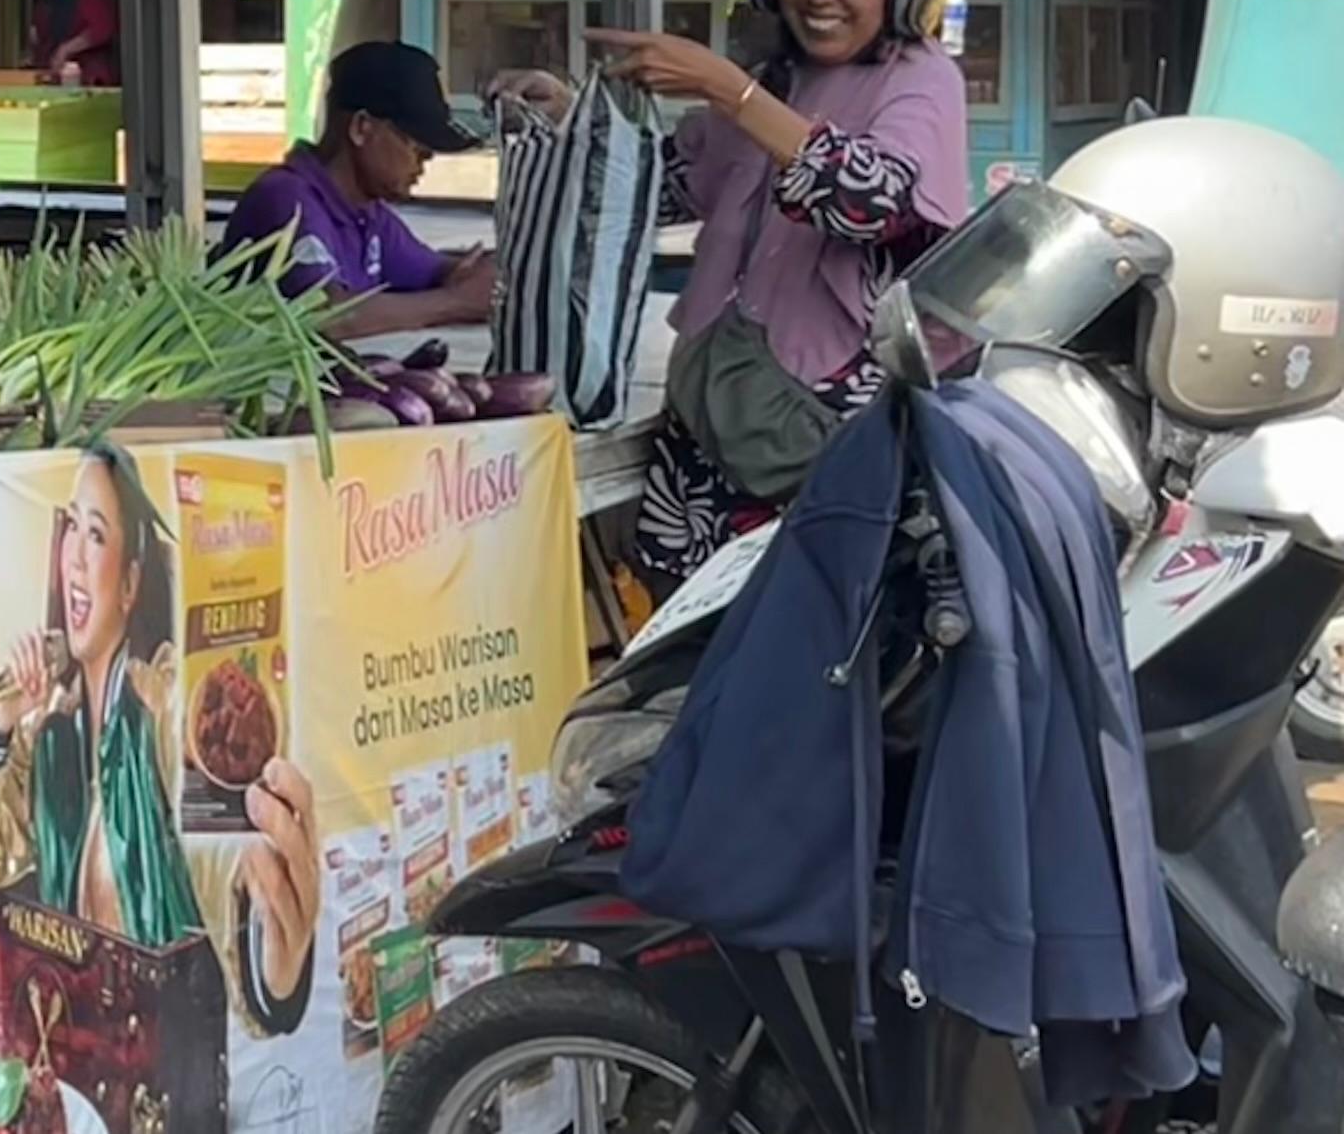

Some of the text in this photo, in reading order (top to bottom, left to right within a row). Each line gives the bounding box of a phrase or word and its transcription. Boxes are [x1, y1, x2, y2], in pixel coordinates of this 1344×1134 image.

[364, 625, 519, 688] Bumbu Warisan
[353, 673, 535, 748] dari Masa ke Masa
